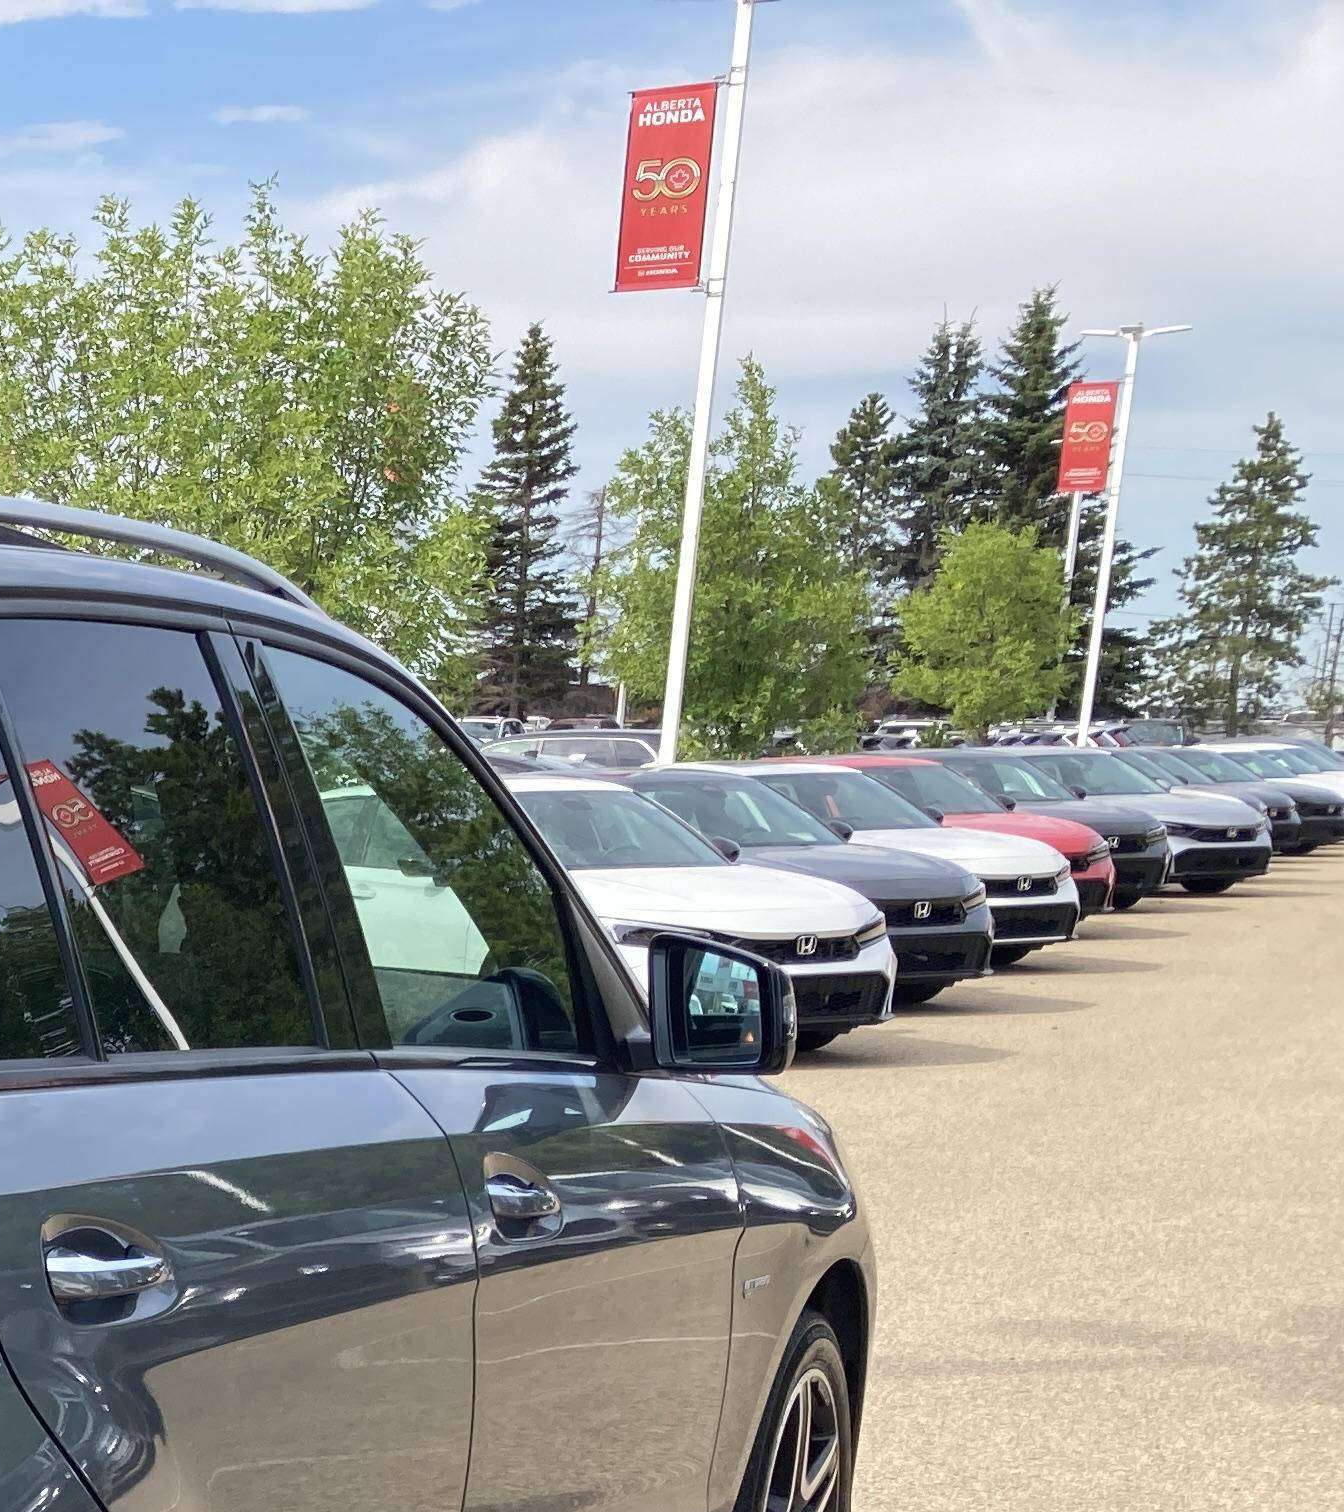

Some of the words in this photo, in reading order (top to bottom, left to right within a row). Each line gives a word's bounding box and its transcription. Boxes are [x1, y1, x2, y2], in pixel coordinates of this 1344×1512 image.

[643, 97, 702, 113] ALBERTA
[638, 107, 705, 127] HONDA
[632, 157, 701, 201] 50
[640, 203, 688, 217] YEARS
[628, 251, 691, 263] COMMUNITY
